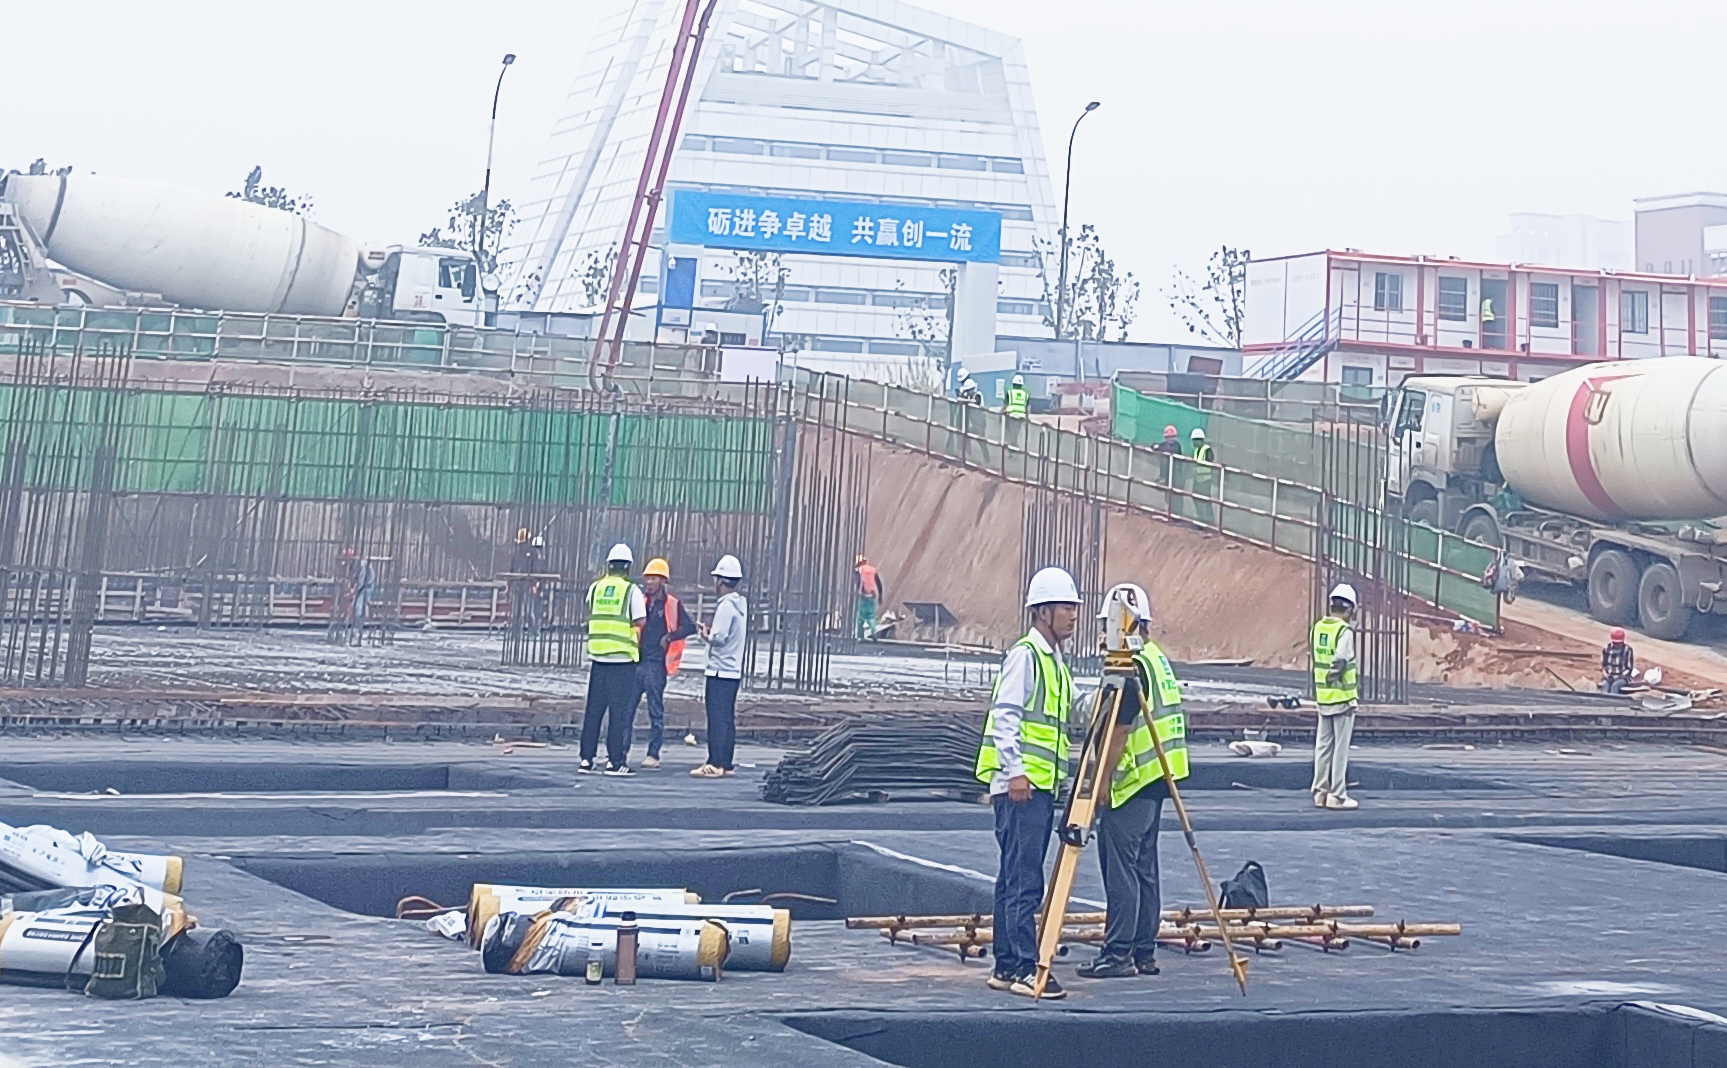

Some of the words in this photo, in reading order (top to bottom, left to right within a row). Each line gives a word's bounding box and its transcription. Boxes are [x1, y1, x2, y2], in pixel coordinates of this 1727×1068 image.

[707, 207, 832, 242] 砺进争卓越
[851, 216, 973, 251] 共赢创一流
